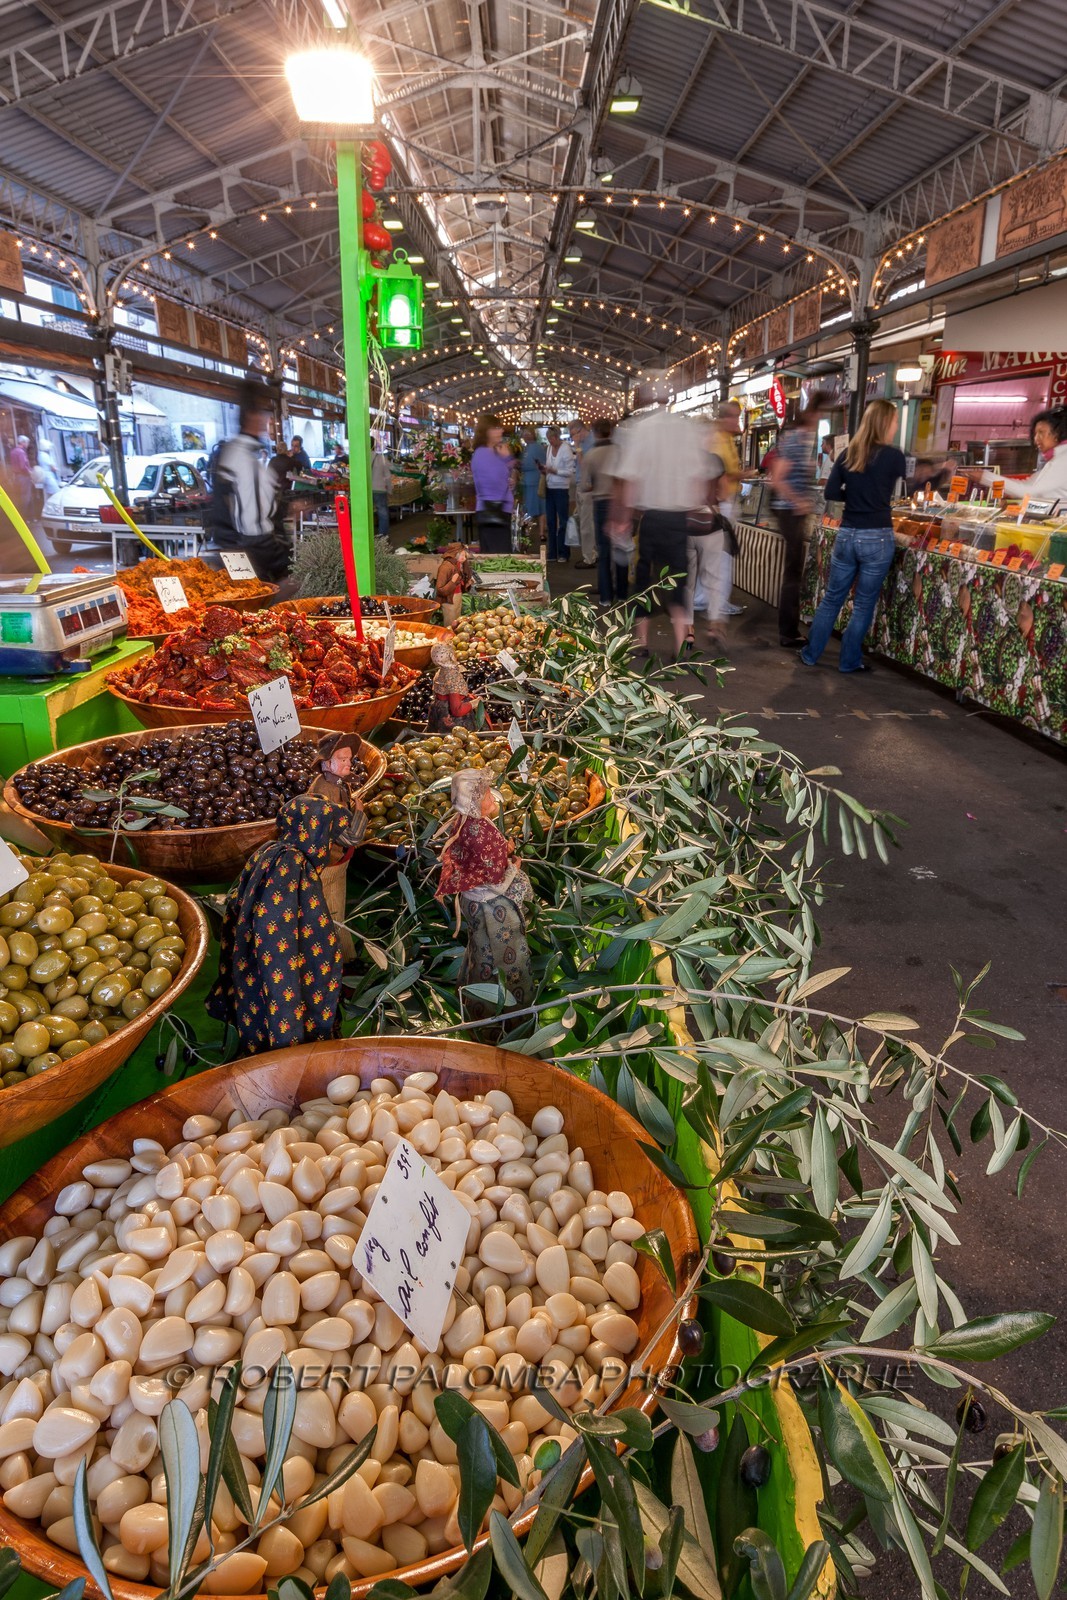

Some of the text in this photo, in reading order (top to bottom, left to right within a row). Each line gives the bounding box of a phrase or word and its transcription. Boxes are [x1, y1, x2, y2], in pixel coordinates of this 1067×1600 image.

[932, 355, 968, 380] Chez
[773, 382, 783, 414] TABAC
[415, 1190, 442, 1257] confit
